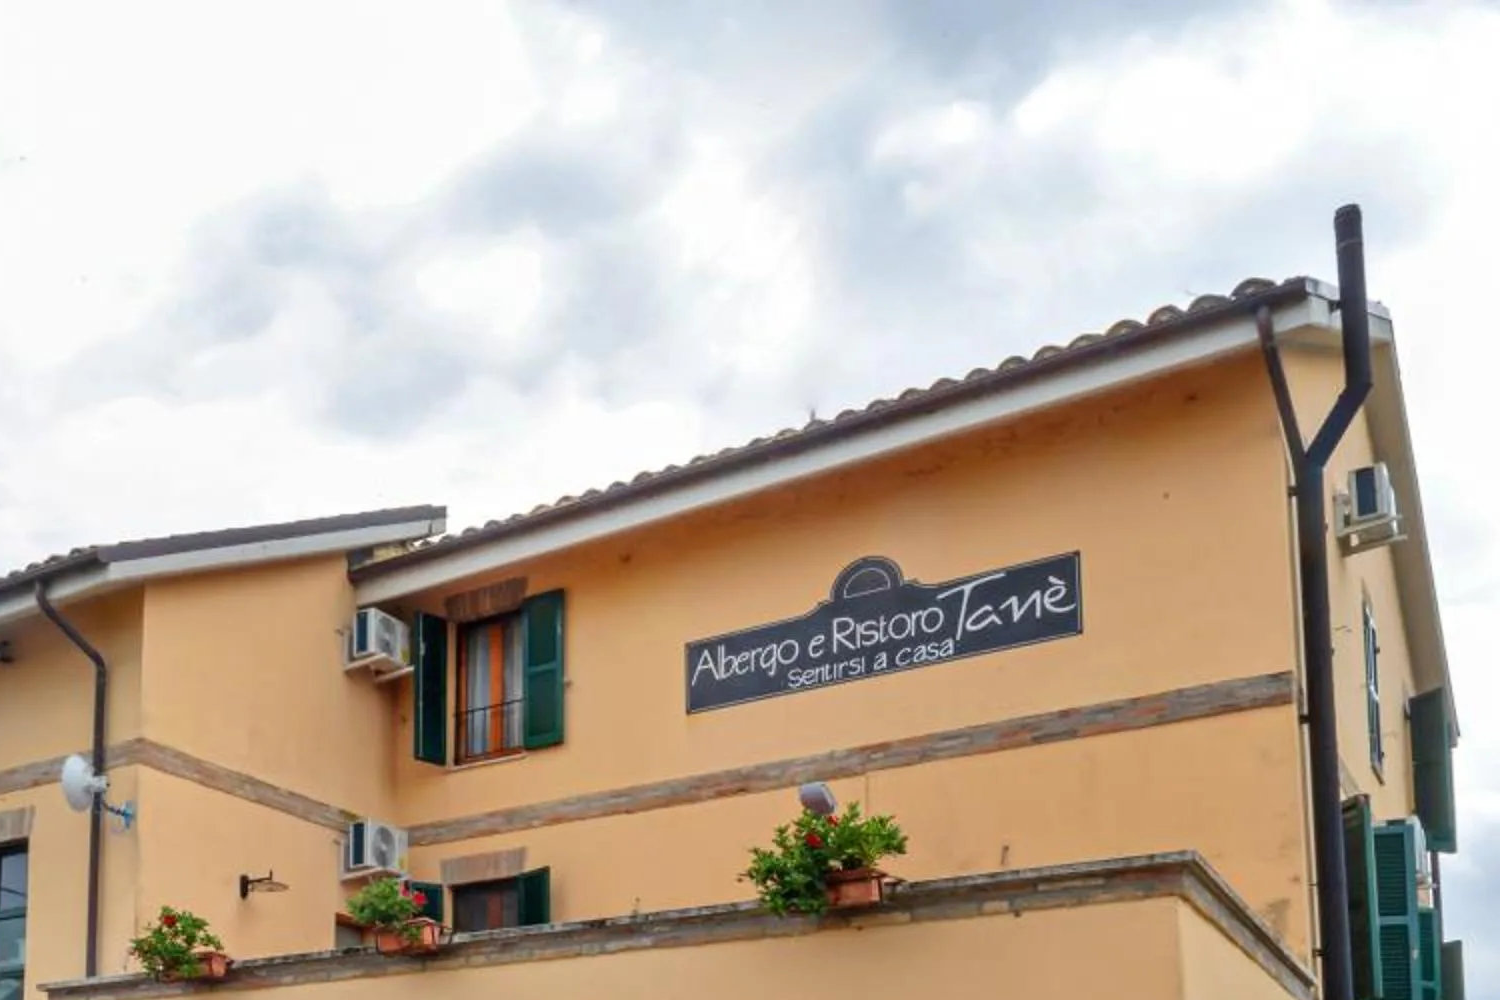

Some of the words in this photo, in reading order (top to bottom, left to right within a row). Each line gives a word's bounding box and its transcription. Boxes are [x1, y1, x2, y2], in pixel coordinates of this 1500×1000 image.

[691, 638, 799, 686] Albergo
[808, 634, 825, 657] e
[832, 607, 943, 652] Ristoro
[937, 573, 1077, 640] Tanè
[874, 652, 887, 670] a
[895, 638, 954, 666] casa
